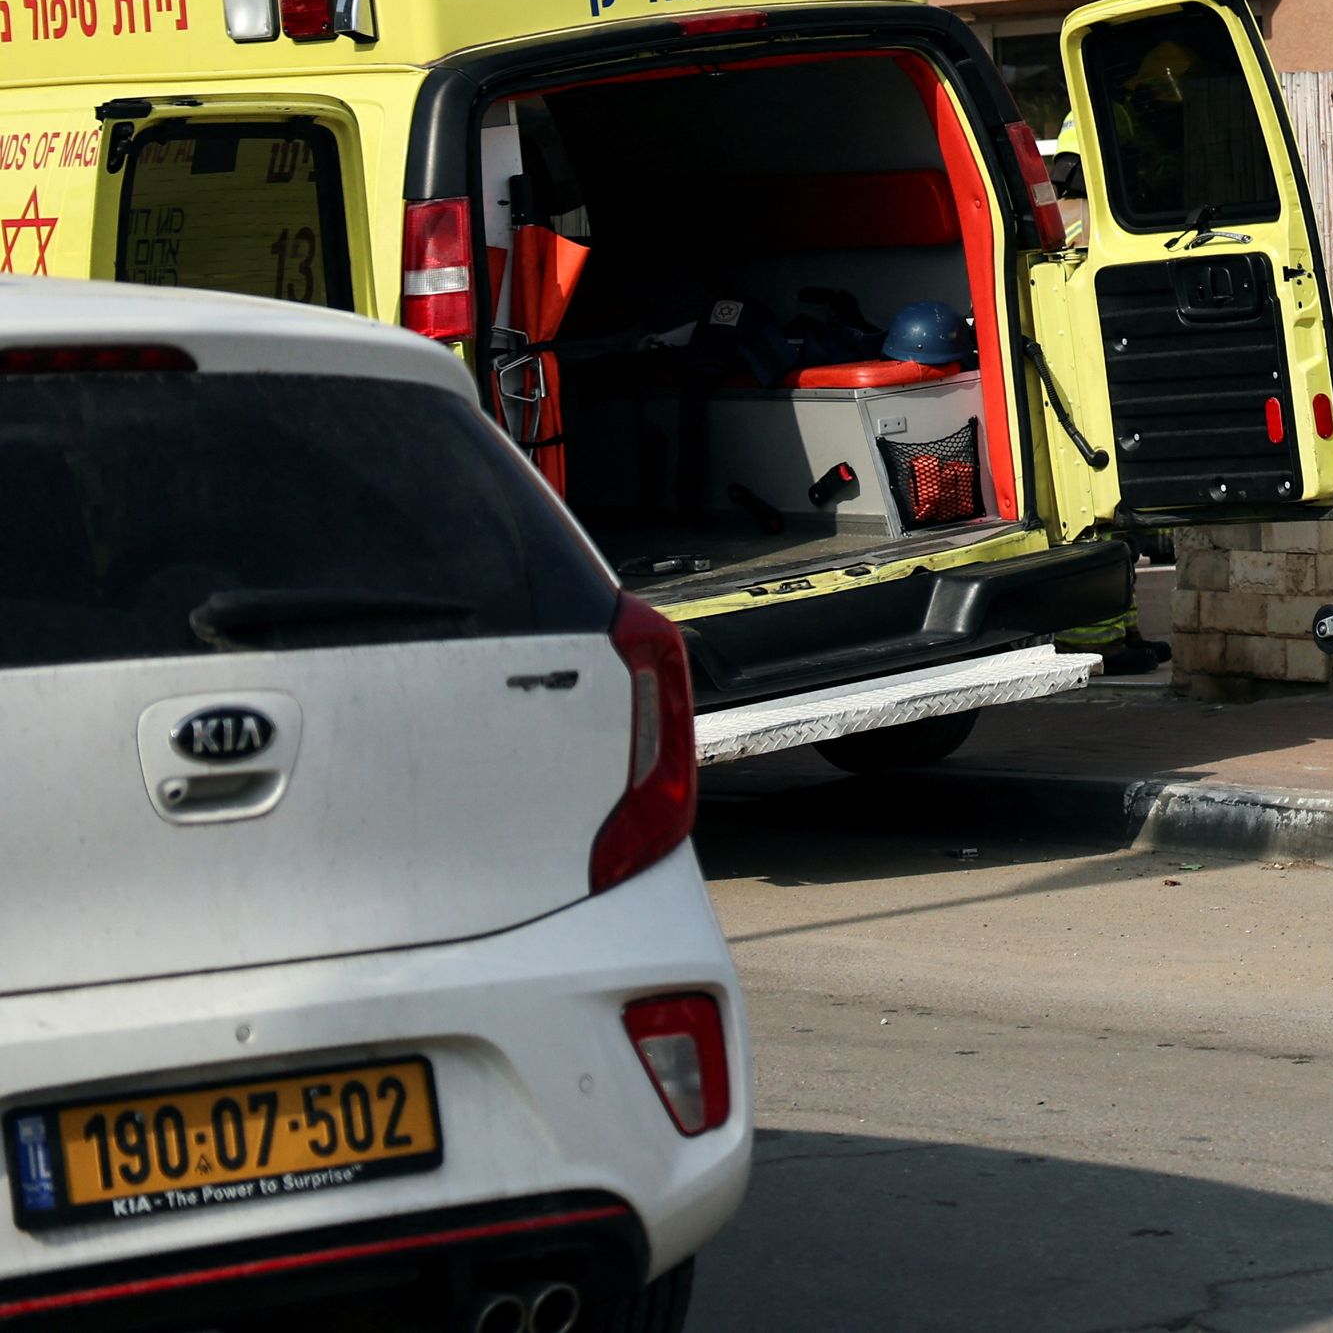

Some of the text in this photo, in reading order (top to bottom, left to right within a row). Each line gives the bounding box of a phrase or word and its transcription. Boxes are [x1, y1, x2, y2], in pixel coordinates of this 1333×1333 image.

[34, 132, 61, 168] OF
[192, 715, 261, 755] KIA
[112, 1196, 152, 1218] KIA
[165, 1188, 198, 1208] The
[202, 1183, 255, 1206] Power
[259, 1180, 278, 1196] to
